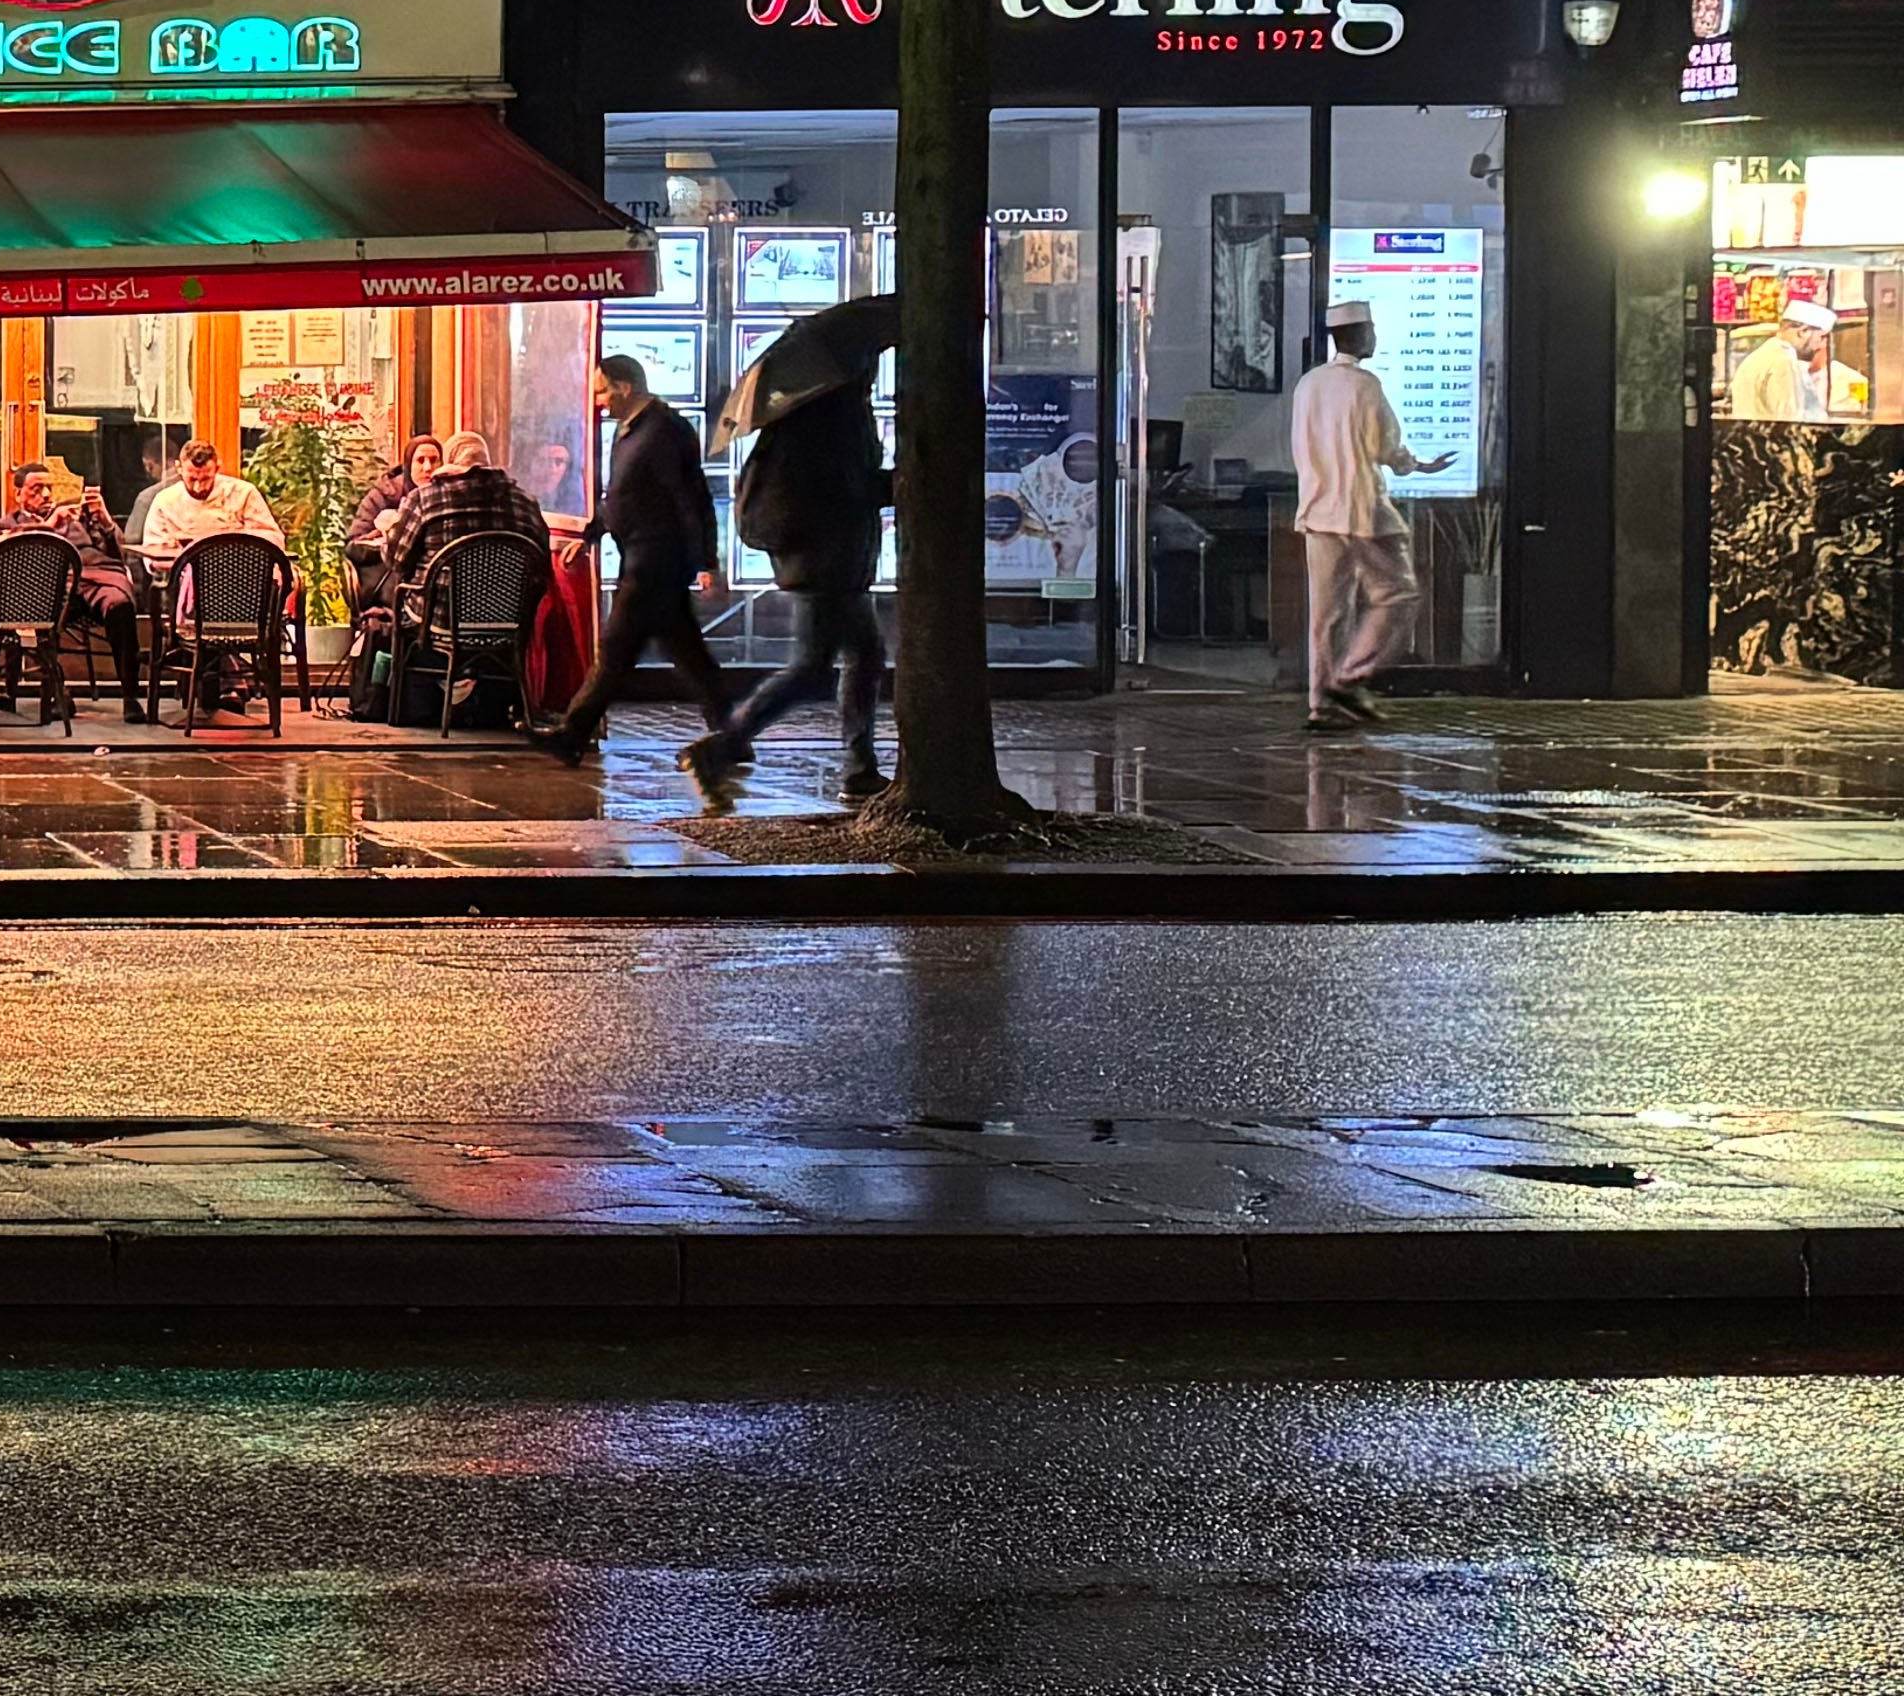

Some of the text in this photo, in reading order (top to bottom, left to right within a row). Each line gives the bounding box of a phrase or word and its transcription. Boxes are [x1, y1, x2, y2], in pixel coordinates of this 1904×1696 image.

[149, 16, 361, 74] BAR
[1156, 28, 1324, 52] Since 1972
[0, 283, 62, 306] لبنانية
[361, 268, 624, 297] www.alarez.co.uk
